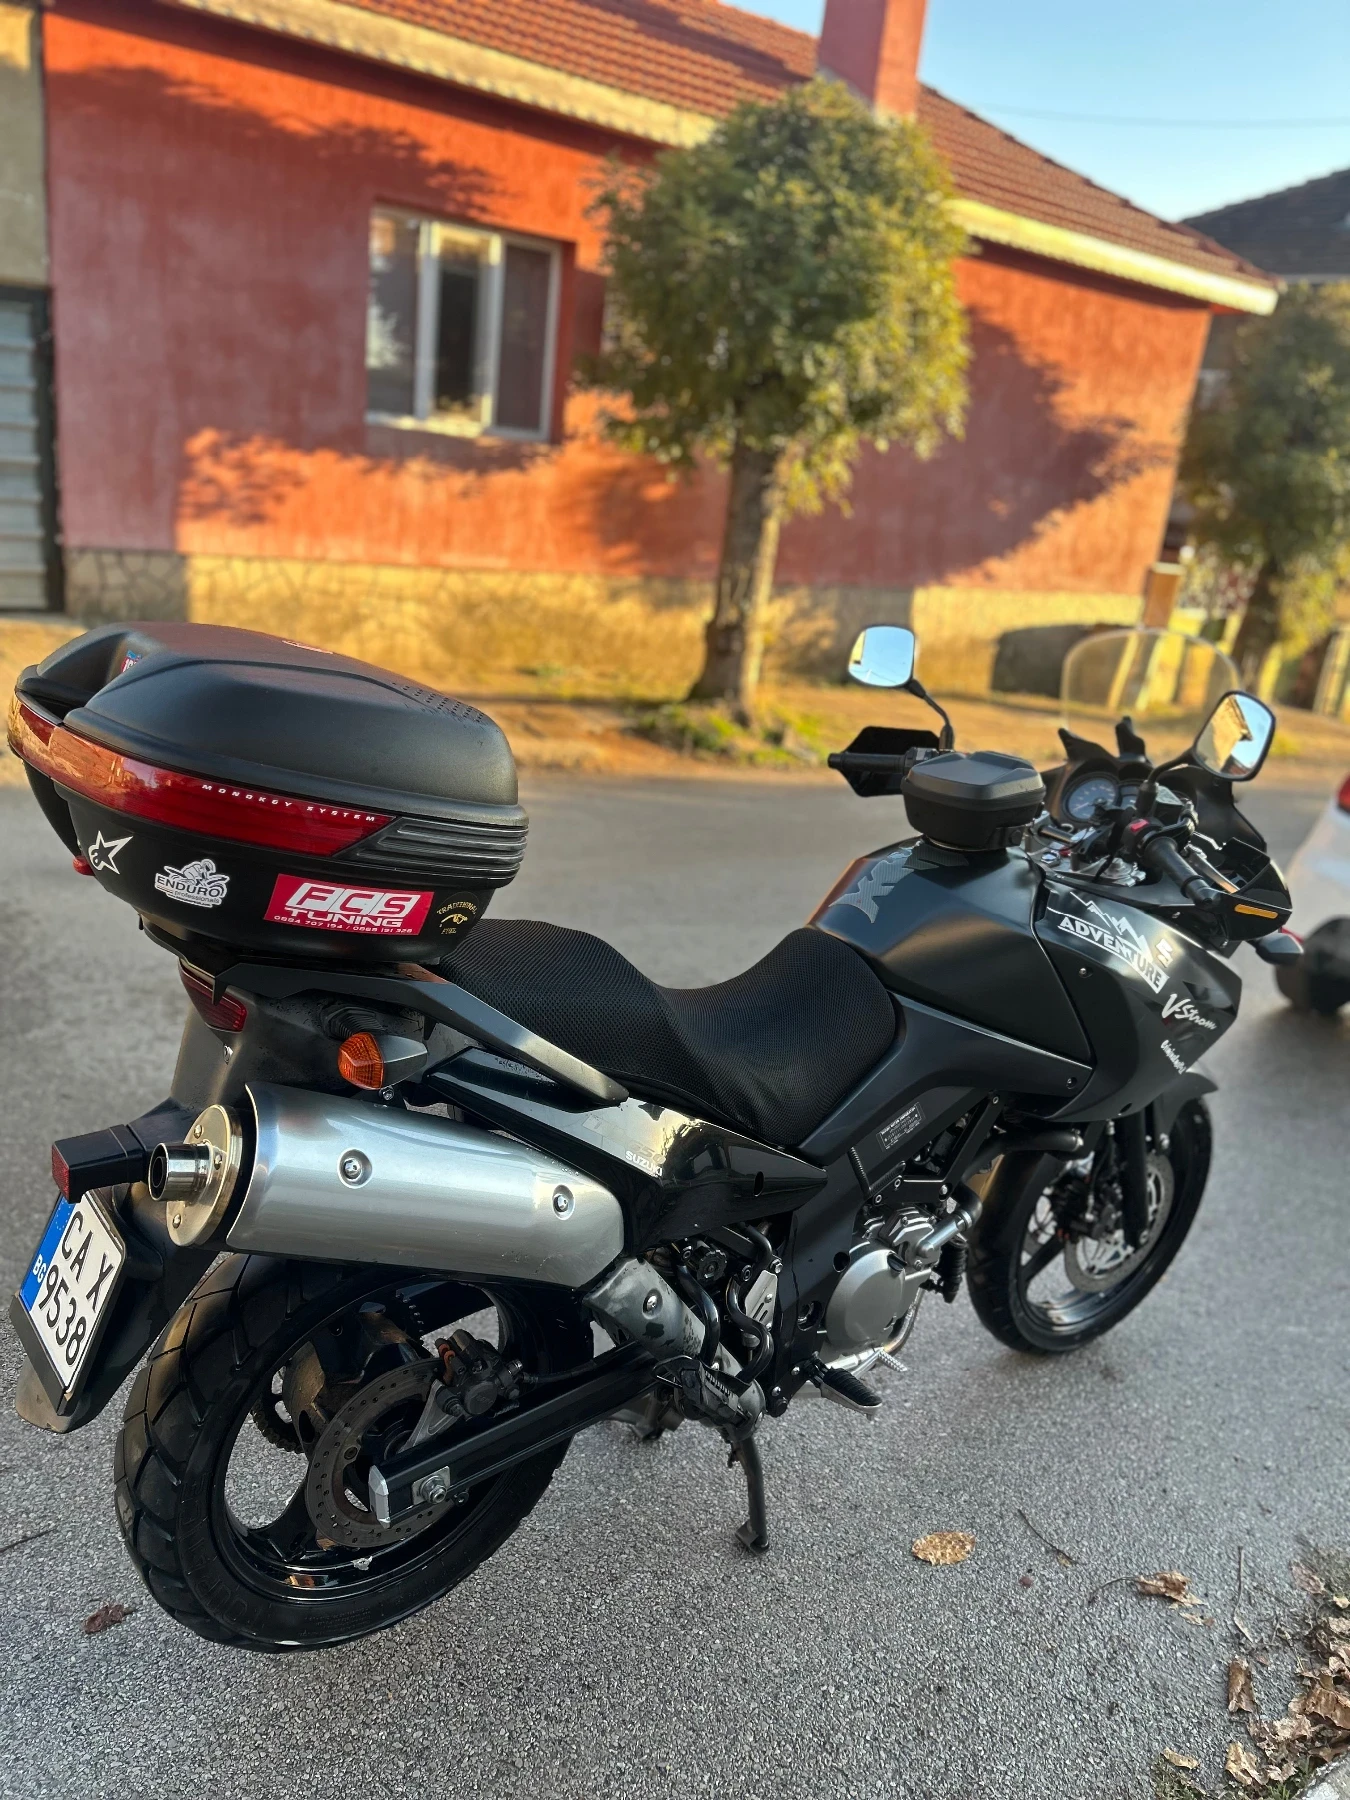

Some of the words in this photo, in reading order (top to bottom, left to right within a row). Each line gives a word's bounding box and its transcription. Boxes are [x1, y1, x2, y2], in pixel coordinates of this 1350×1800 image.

[306, 806, 375, 822] SYSTEM
[157, 875, 221, 898] ENDURO
[284, 906, 404, 927] TUNING
[1060, 916, 1162, 988] ADVENTURE
[625, 1150, 663, 1177] SUZUKI
[32, 1254, 48, 1284] BG
[61, 1211, 93, 1283] CA
[86, 1252, 114, 1312] X
[38, 1264, 87, 1366] 9538
